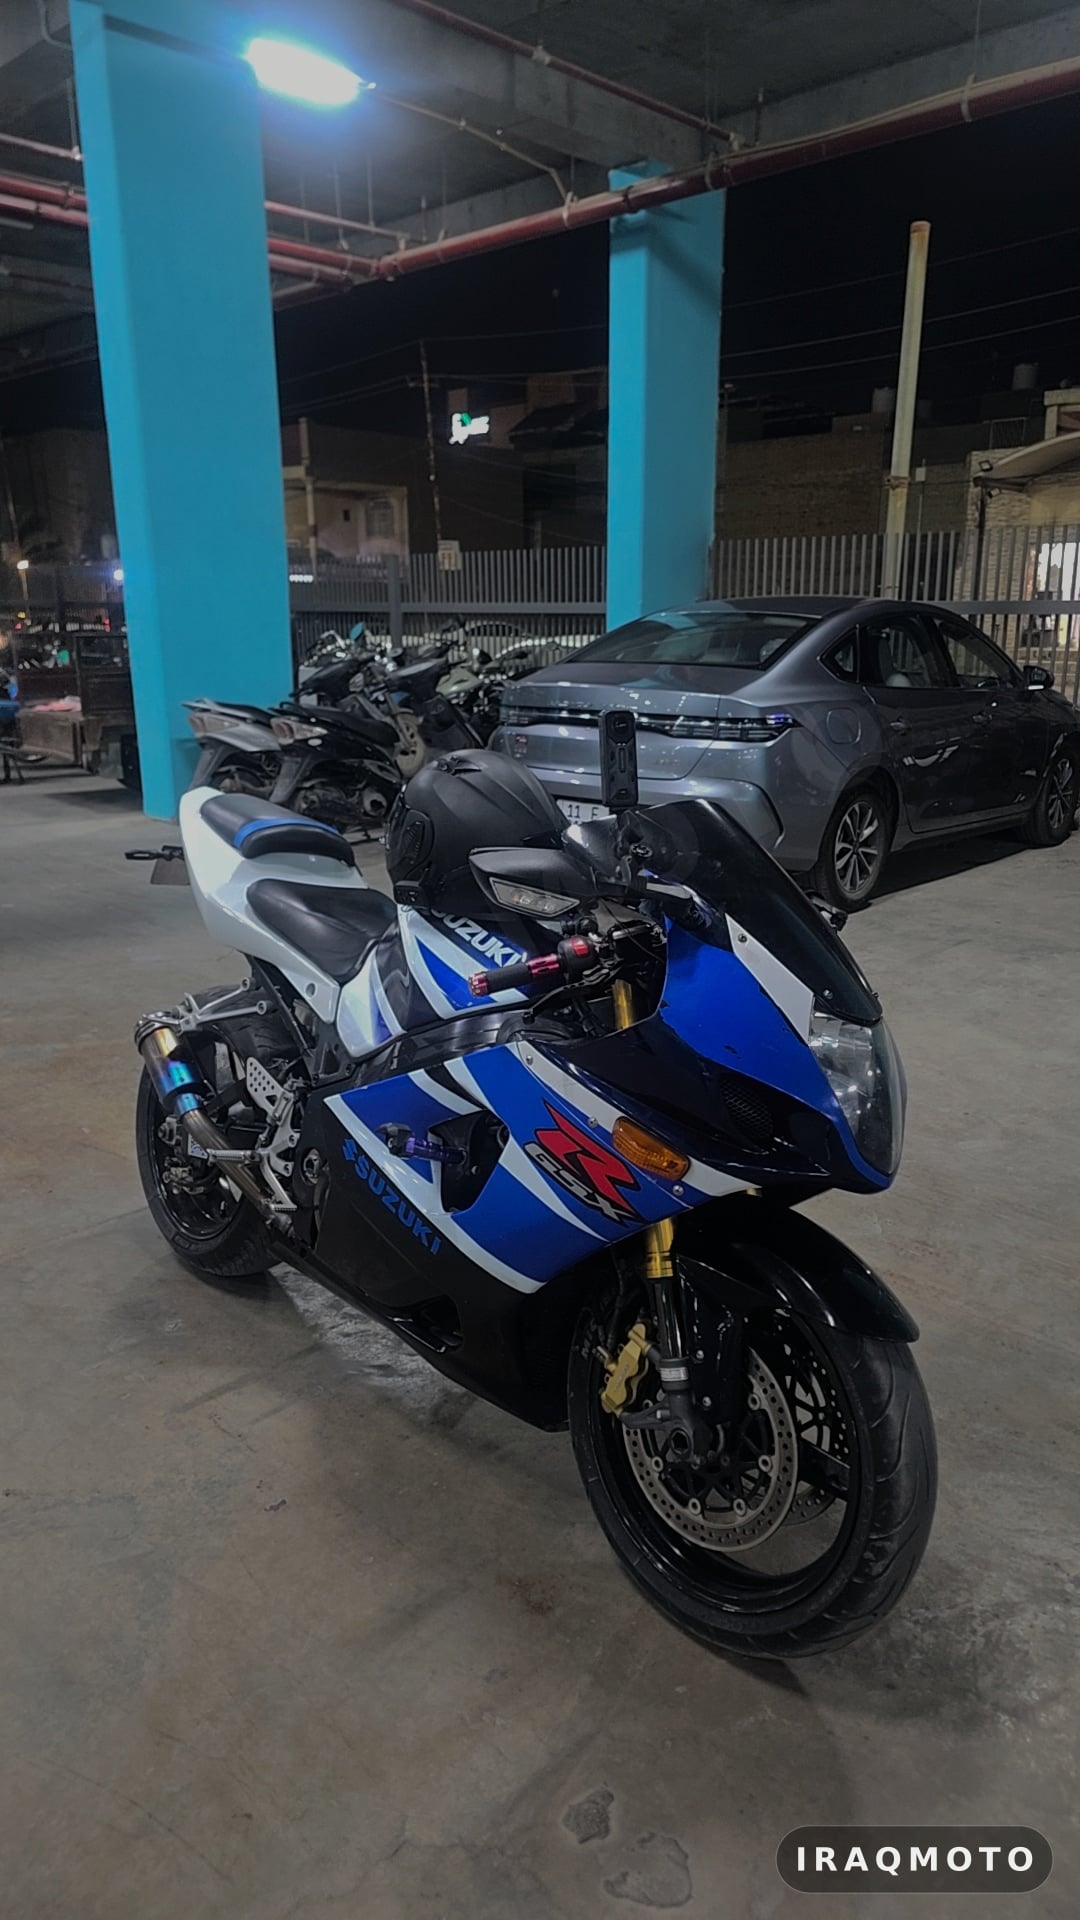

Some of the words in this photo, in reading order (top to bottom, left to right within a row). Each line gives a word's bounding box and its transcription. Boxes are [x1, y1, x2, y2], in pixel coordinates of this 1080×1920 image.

[567, 804, 580, 818] 11
[354, 1155, 441, 1255] SUZUKI
[524, 1142, 635, 1221] GSX
